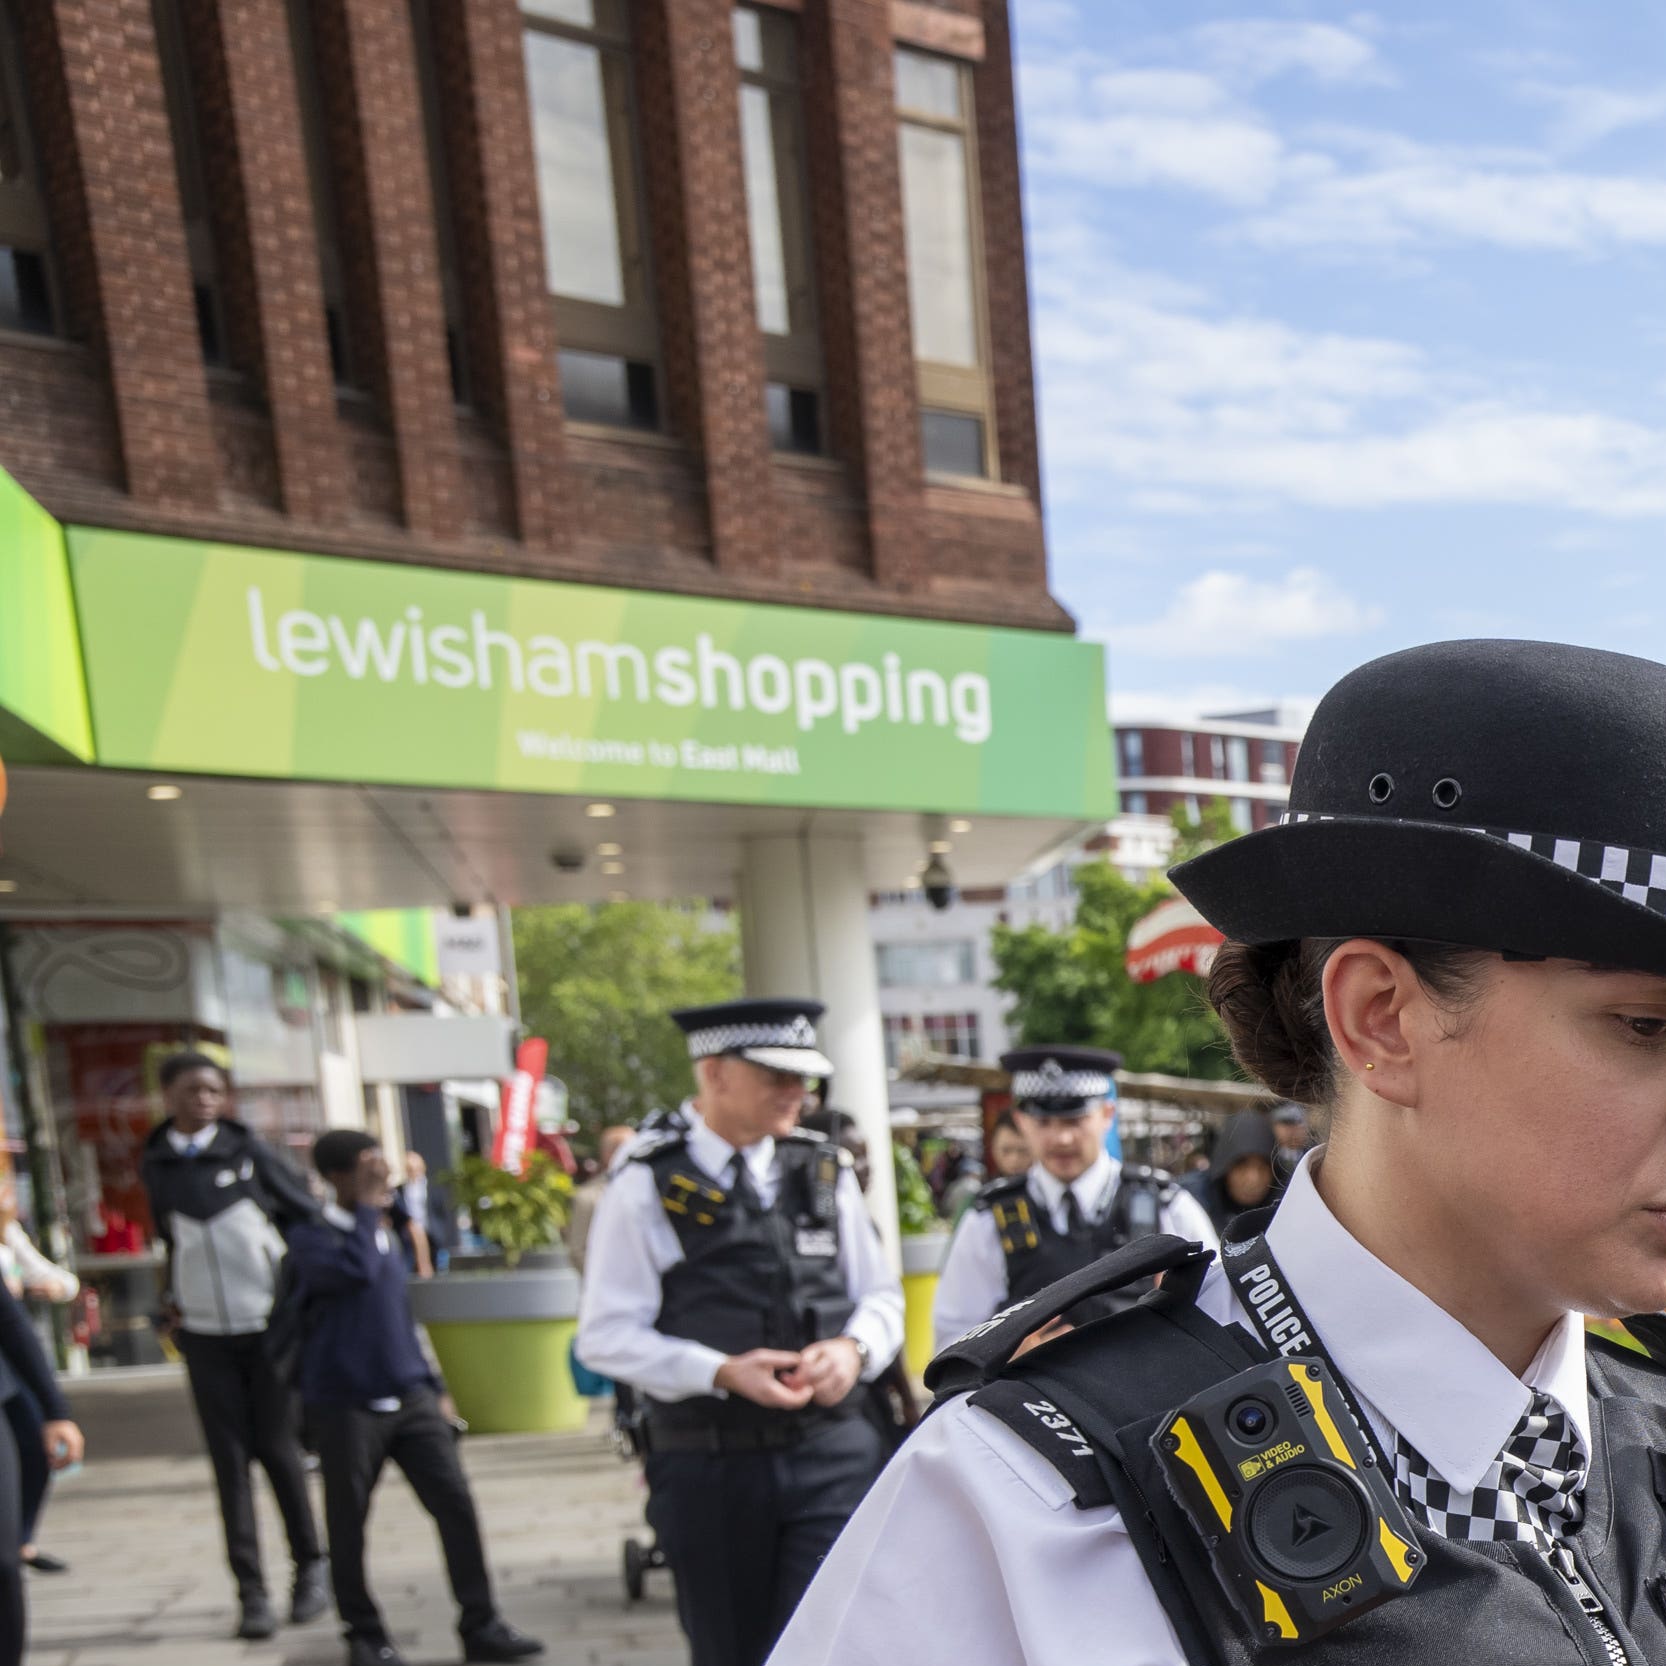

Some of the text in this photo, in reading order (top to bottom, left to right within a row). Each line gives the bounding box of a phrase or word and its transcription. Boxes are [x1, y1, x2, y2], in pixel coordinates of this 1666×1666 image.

[249, 586, 992, 743] lewishamshopping
[680, 738, 739, 771] East
[1239, 1263, 1312, 1357] POLICE
[1023, 1400, 1094, 1457] 2371
[1260, 1441, 1291, 1461] VIDEO
[1265, 1444, 1305, 1470] & AUDIO
[1322, 1573, 1363, 1603] AXON
